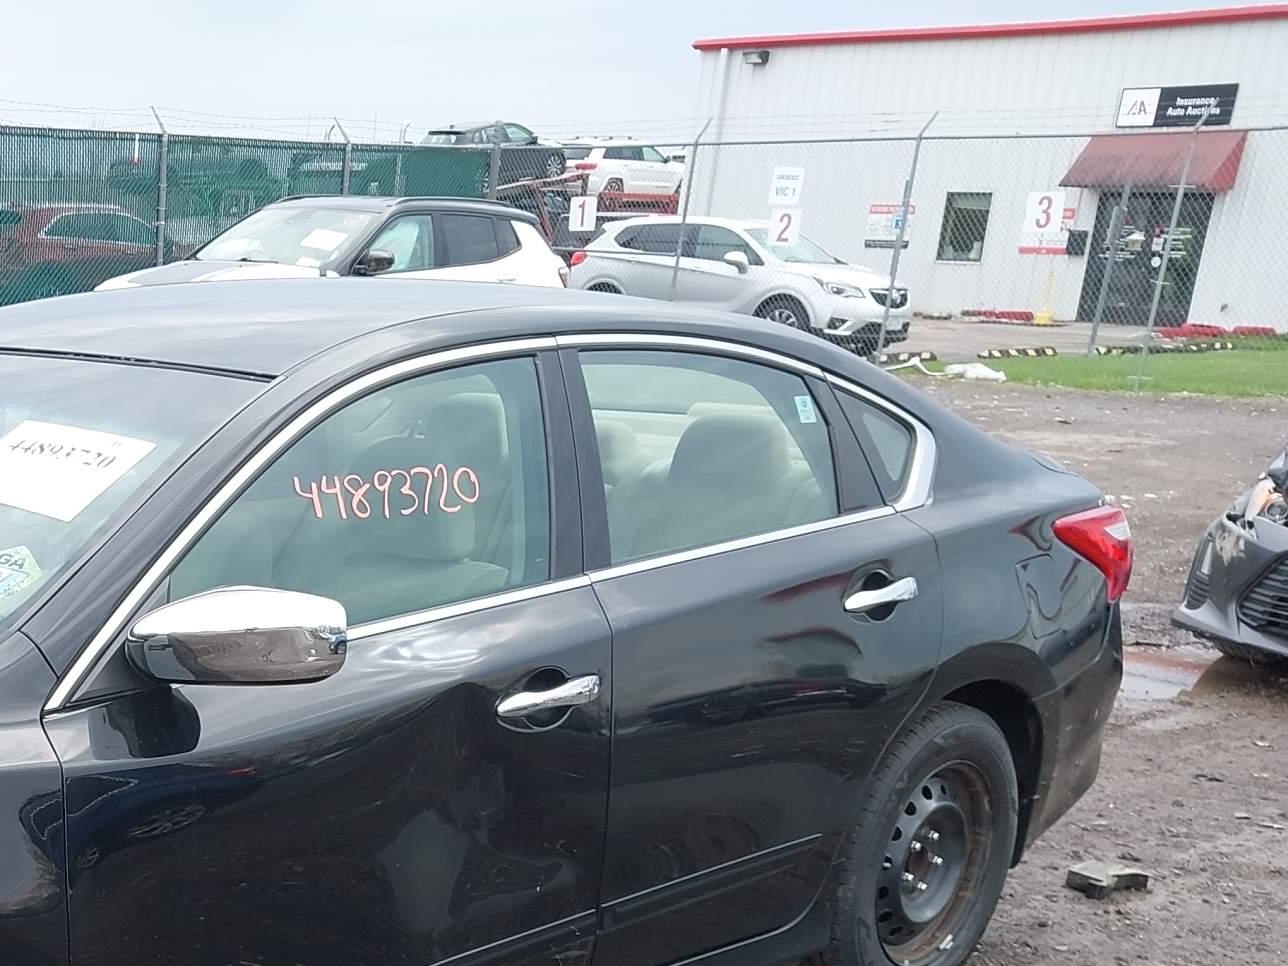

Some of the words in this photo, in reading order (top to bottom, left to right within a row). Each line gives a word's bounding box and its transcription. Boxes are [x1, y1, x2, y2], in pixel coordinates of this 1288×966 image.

[1166, 106, 1185, 116] Auto
[1186, 105, 1221, 116] Auctins
[1175, 97, 1216, 106] Insurance
[775, 186, 790, 197] VIC
[577, 199, 587, 228] 1
[1035, 195, 1053, 229] 3
[775, 212, 793, 243] 2
[9, 439, 117, 469] 44893720
[292, 463, 480, 519] 44893720
